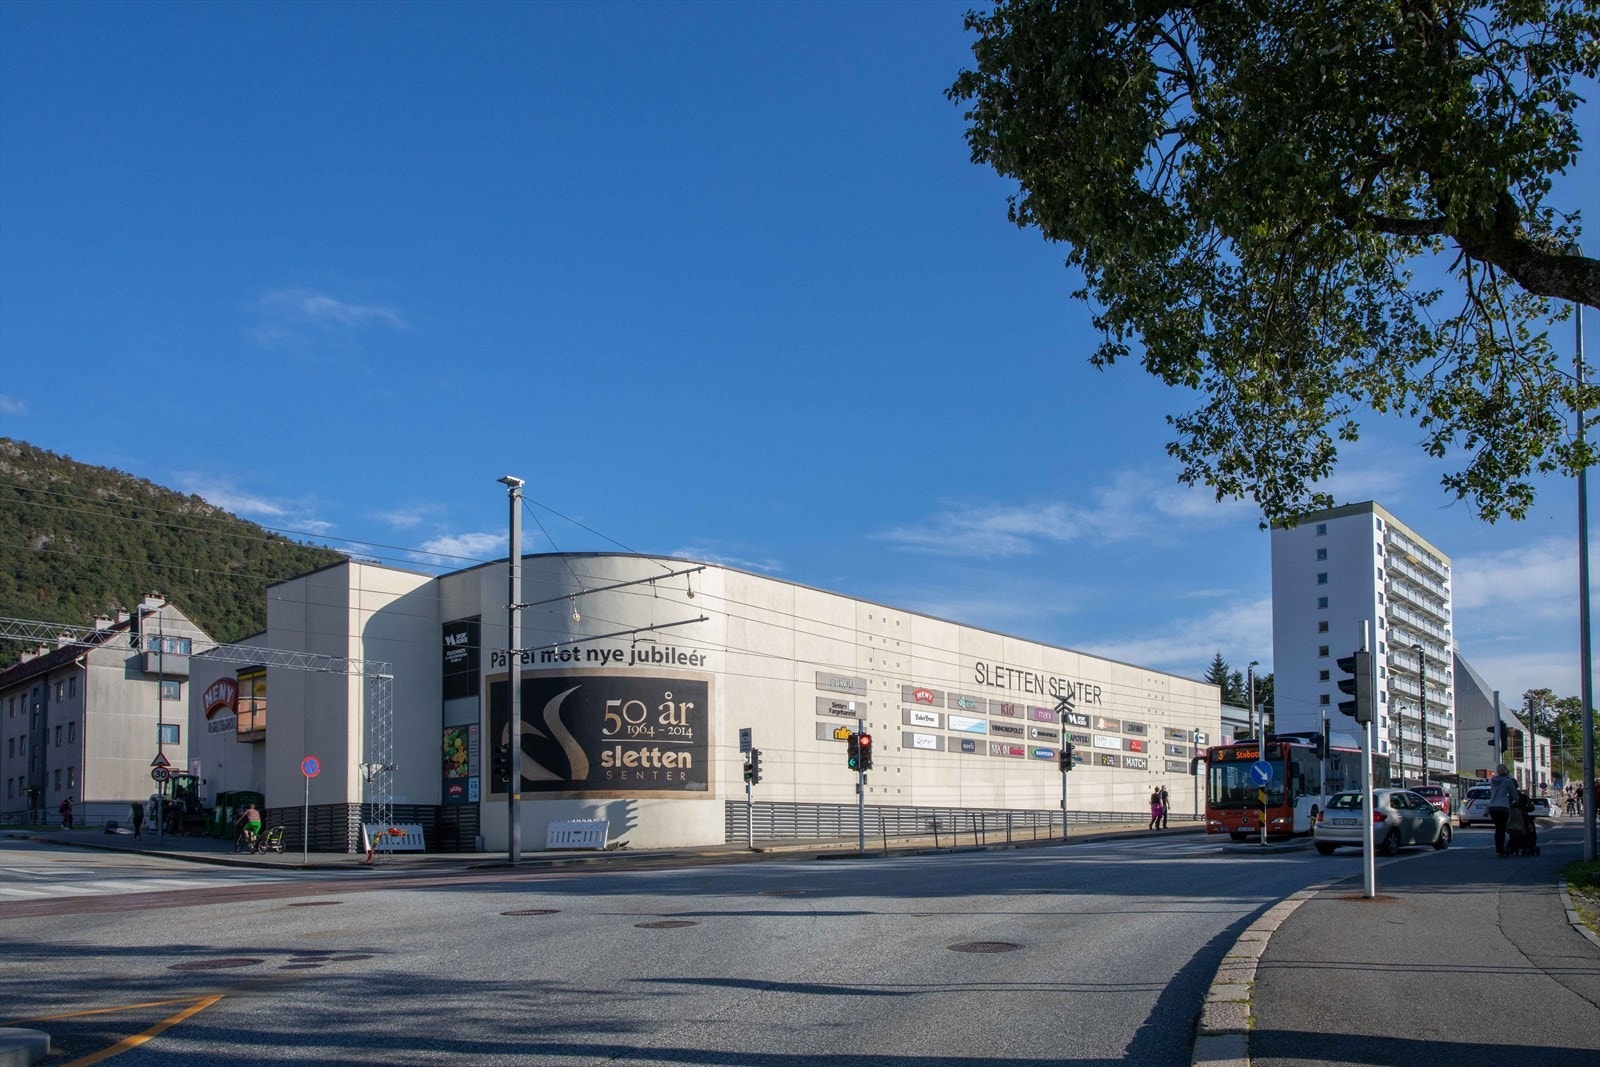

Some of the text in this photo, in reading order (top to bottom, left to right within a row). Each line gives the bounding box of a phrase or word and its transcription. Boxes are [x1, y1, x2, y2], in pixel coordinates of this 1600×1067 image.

[491, 648, 507, 668] På
[541, 646, 581, 664] mot
[586, 648, 624, 667] nye
[628, 644, 707, 667] jubileér
[974, 661, 1102, 705] SLETTEN SENTER
[204, 683, 235, 706] MENY
[916, 691, 933, 701] MENY
[602, 691, 695, 735] 50 år
[1000, 703, 1015, 717] Kid
[627, 722, 656, 738] 1964
[668, 726, 693, 739] 2014
[600, 745, 693, 769] sletten
[1126, 757, 1146, 768] MATCH
[155, 769, 167, 779] 30
[606, 771, 686, 781] SENTER
